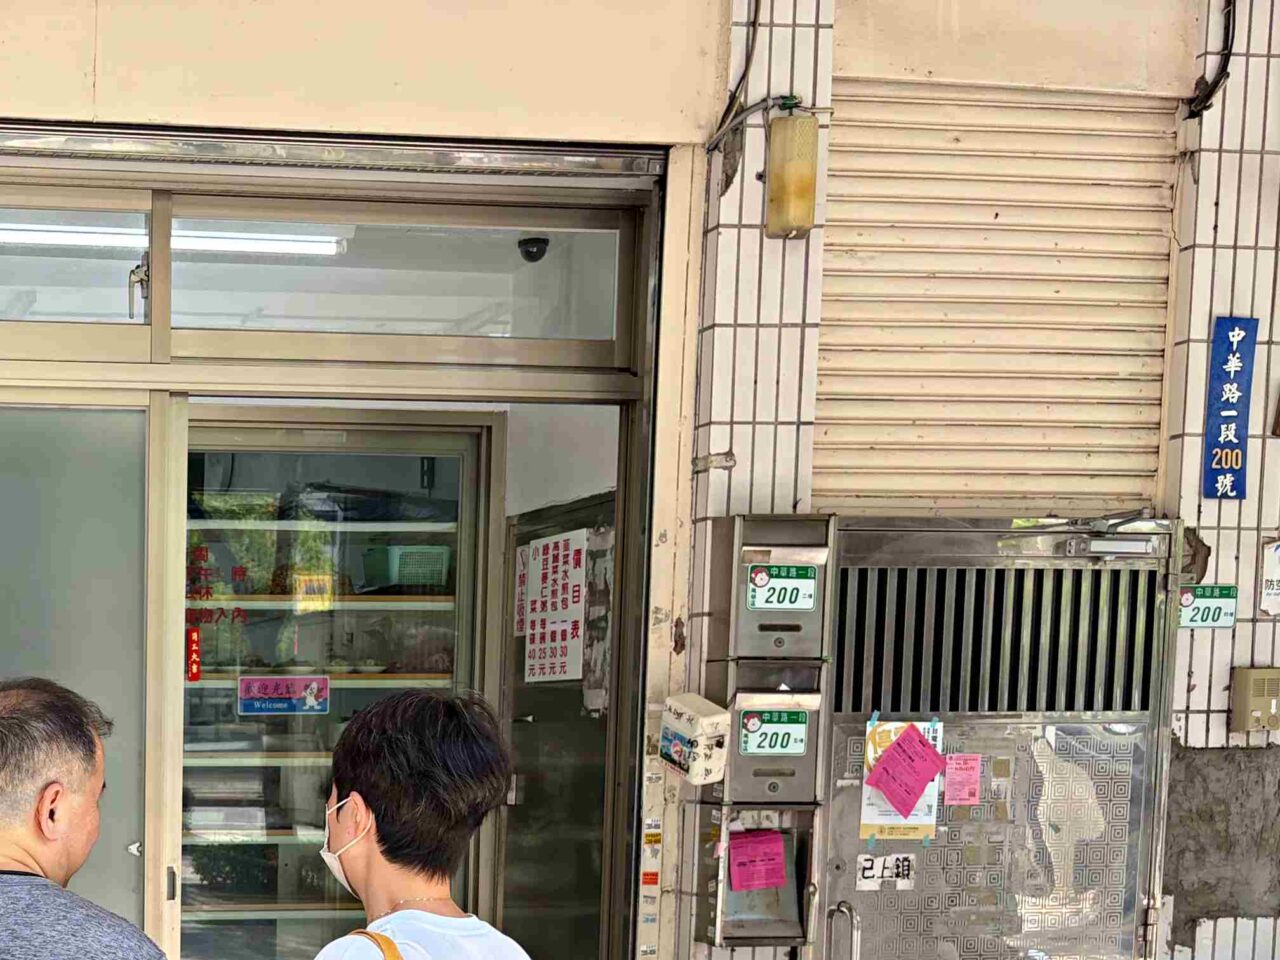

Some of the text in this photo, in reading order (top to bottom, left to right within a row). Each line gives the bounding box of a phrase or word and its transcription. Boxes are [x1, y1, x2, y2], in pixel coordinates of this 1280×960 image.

[1211, 326, 1246, 498] 中華路一段200號
[770, 566, 816, 578] 中華路一段
[570, 548, 582, 640] 價目表
[765, 587, 800, 604] 200
[1189, 606, 1223, 623] 200
[254, 701, 288, 709] Welcome
[757, 732, 791, 749] 200
